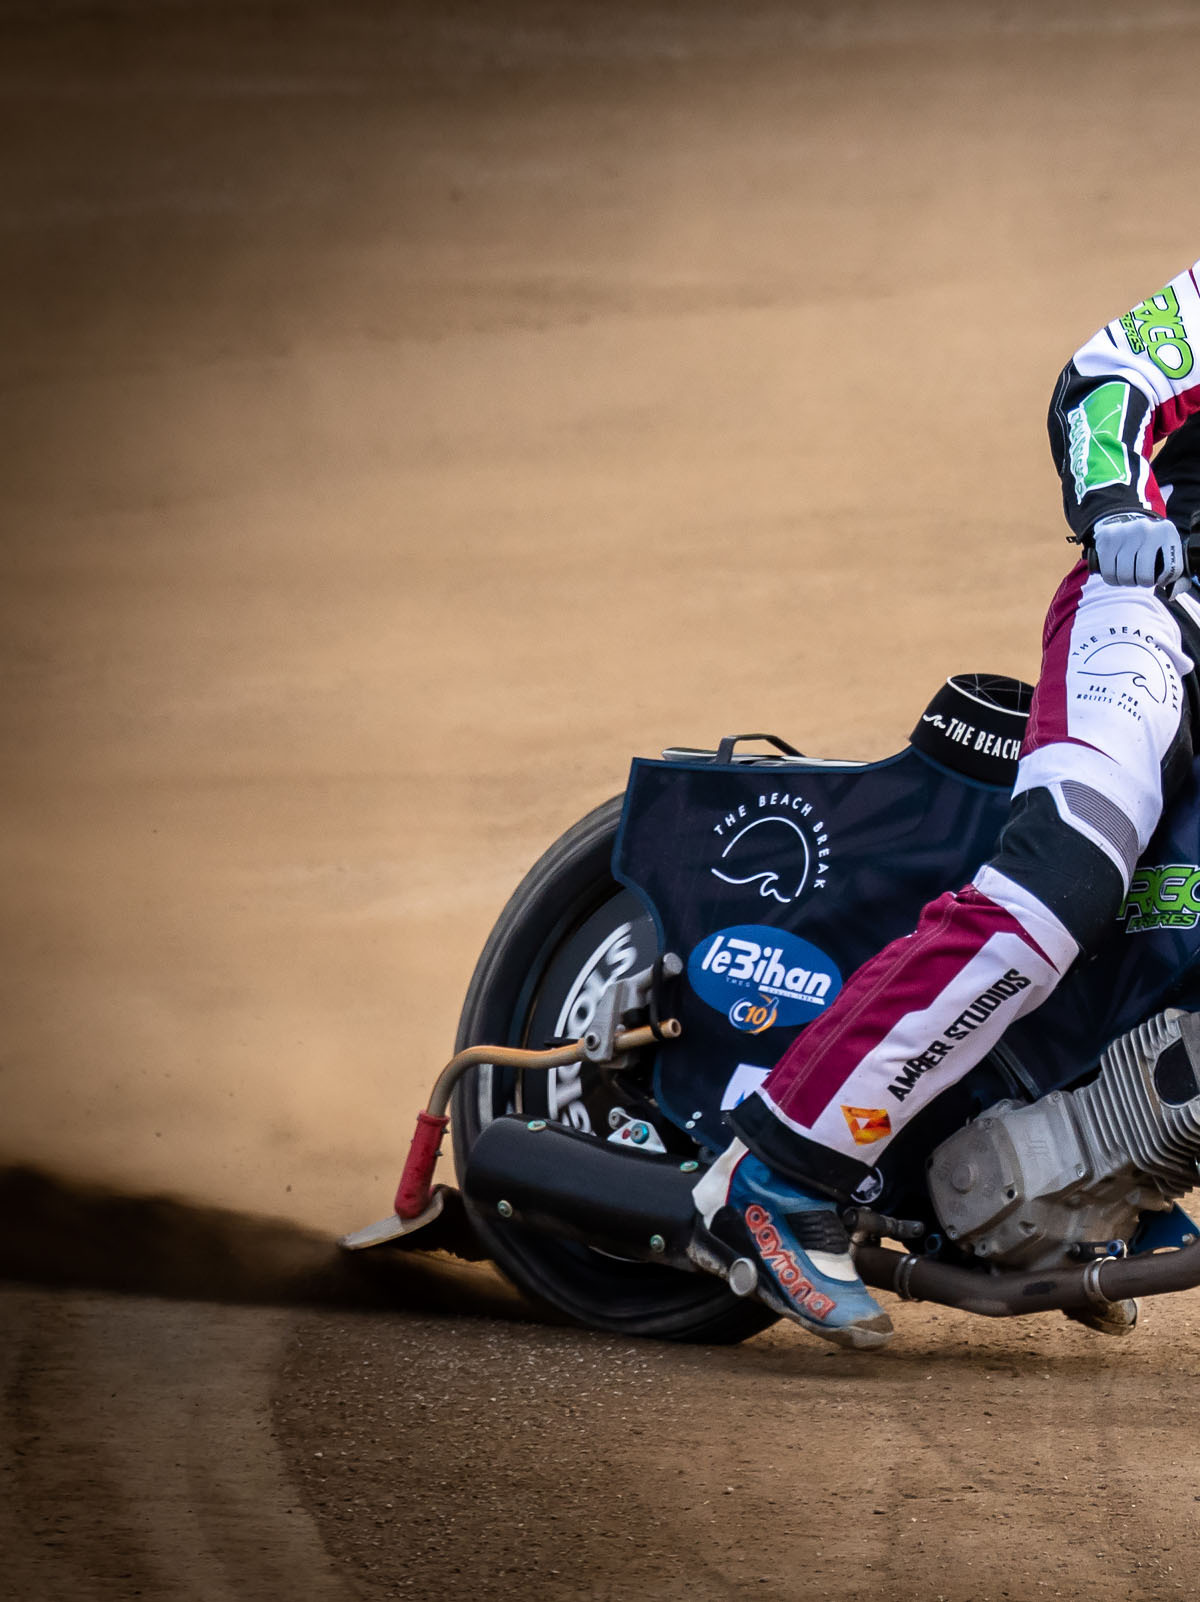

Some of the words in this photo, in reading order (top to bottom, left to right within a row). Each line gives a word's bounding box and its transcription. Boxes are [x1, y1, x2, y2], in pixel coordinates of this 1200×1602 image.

[945, 717, 976, 746] THE
[973, 730, 1021, 761] BEACH
[713, 804, 747, 836] THE
[758, 792, 814, 817] BEACH
[812, 821, 831, 889] BREAK
[732, 1001, 768, 1025] C10
[887, 1040, 954, 1102] AMBER
[943, 968, 1032, 1041] STUDIOS
[745, 1204, 837, 1320] daytona
